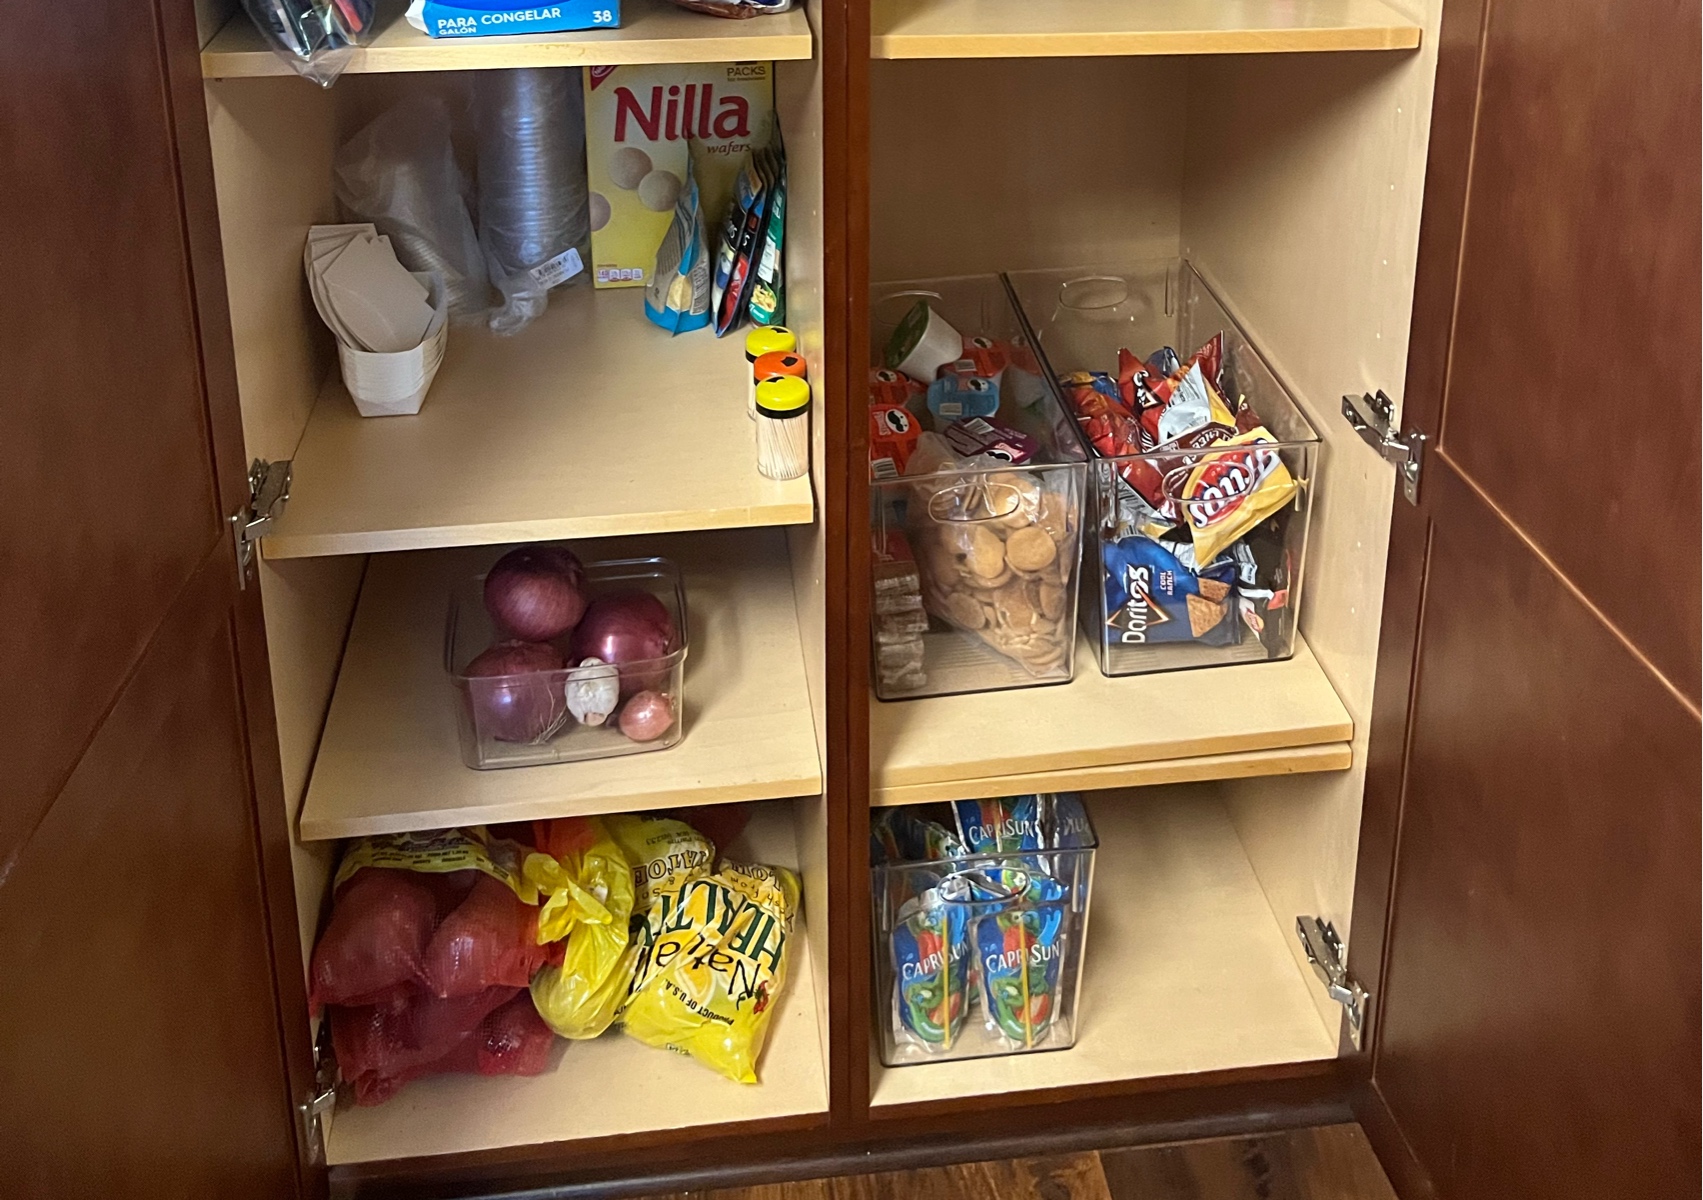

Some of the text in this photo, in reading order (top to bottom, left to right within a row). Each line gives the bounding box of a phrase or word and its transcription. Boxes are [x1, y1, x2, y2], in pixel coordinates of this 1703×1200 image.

[437, 7, 562, 30] PARA CONGELAR
[592, 10, 613, 24] 38
[438, 26, 477, 36] GALÓN
[726, 65, 766, 77] PACKS
[613, 83, 751, 142] Nilla
[707, 140, 751, 156] wafers
[1122, 564, 1150, 644] Doritos
[685, 999, 698, 1011] OF
